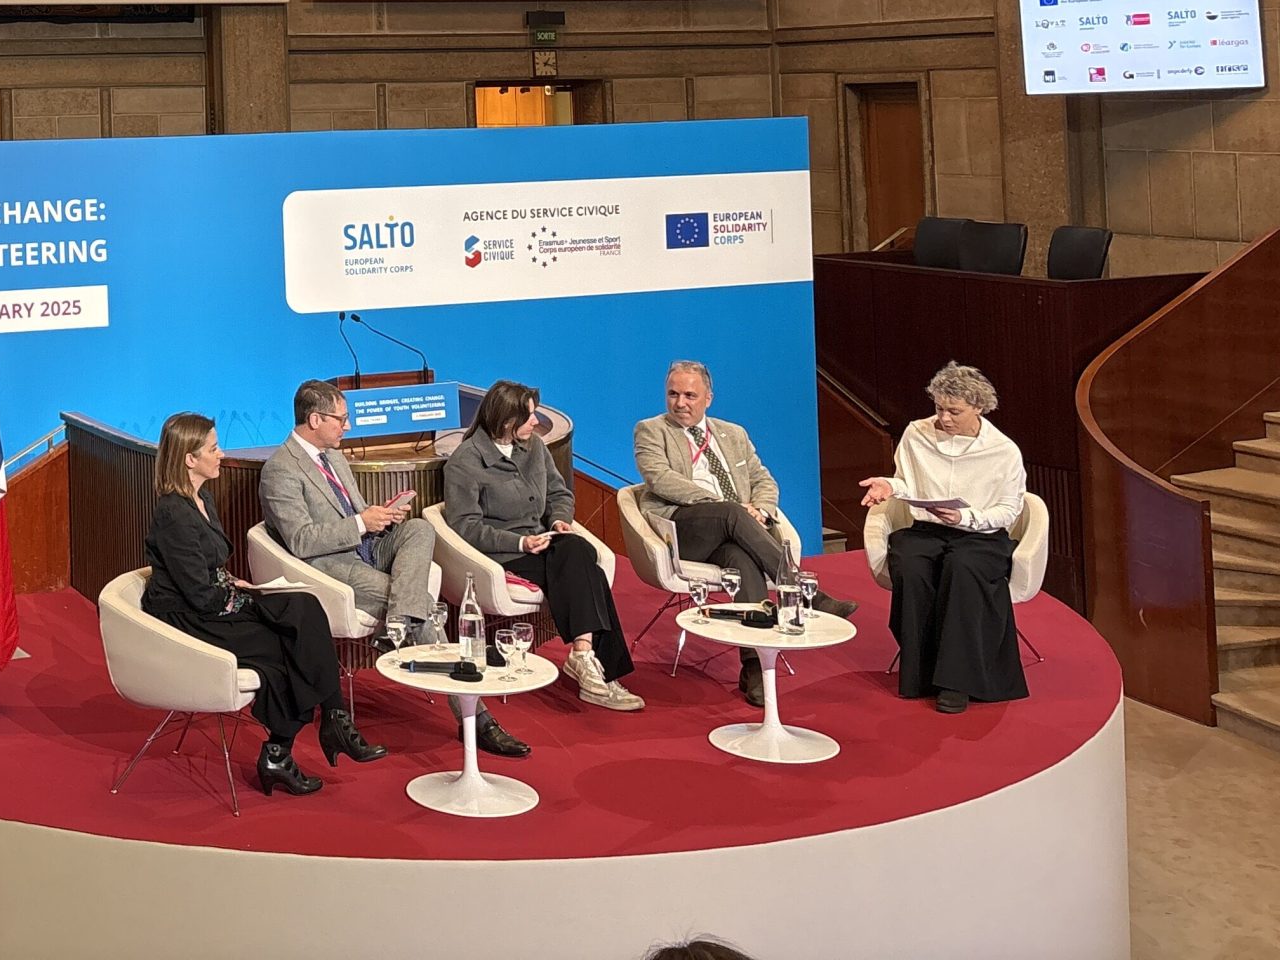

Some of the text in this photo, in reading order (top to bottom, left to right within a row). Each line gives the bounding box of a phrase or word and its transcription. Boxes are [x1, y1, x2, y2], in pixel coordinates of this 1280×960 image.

[537, 32, 556, 40] SORTIE
[463, 204, 621, 222] AGENCE DU SERVICE CIVIQUE
[713, 211, 762, 222] EUROPEAN
[713, 222, 768, 234] SOLIDARITY
[343, 221, 414, 251] SALTO
[538, 239, 568, 247] Erasmus+
[569, 238, 597, 246] Jeunesse
[604, 236, 621, 244] Sport
[714, 235, 744, 245] CORPS
[483, 239, 514, 250] SERVICE
[538, 247, 557, 255] Corps
[558, 245, 585, 253] européen
[483, 250, 515, 261] CIVIQUE
[344, 257, 384, 266] EUROPEAN
[345, 265, 413, 275] SOLIDARITY CORPS
[40, 299, 82, 319] 2025
